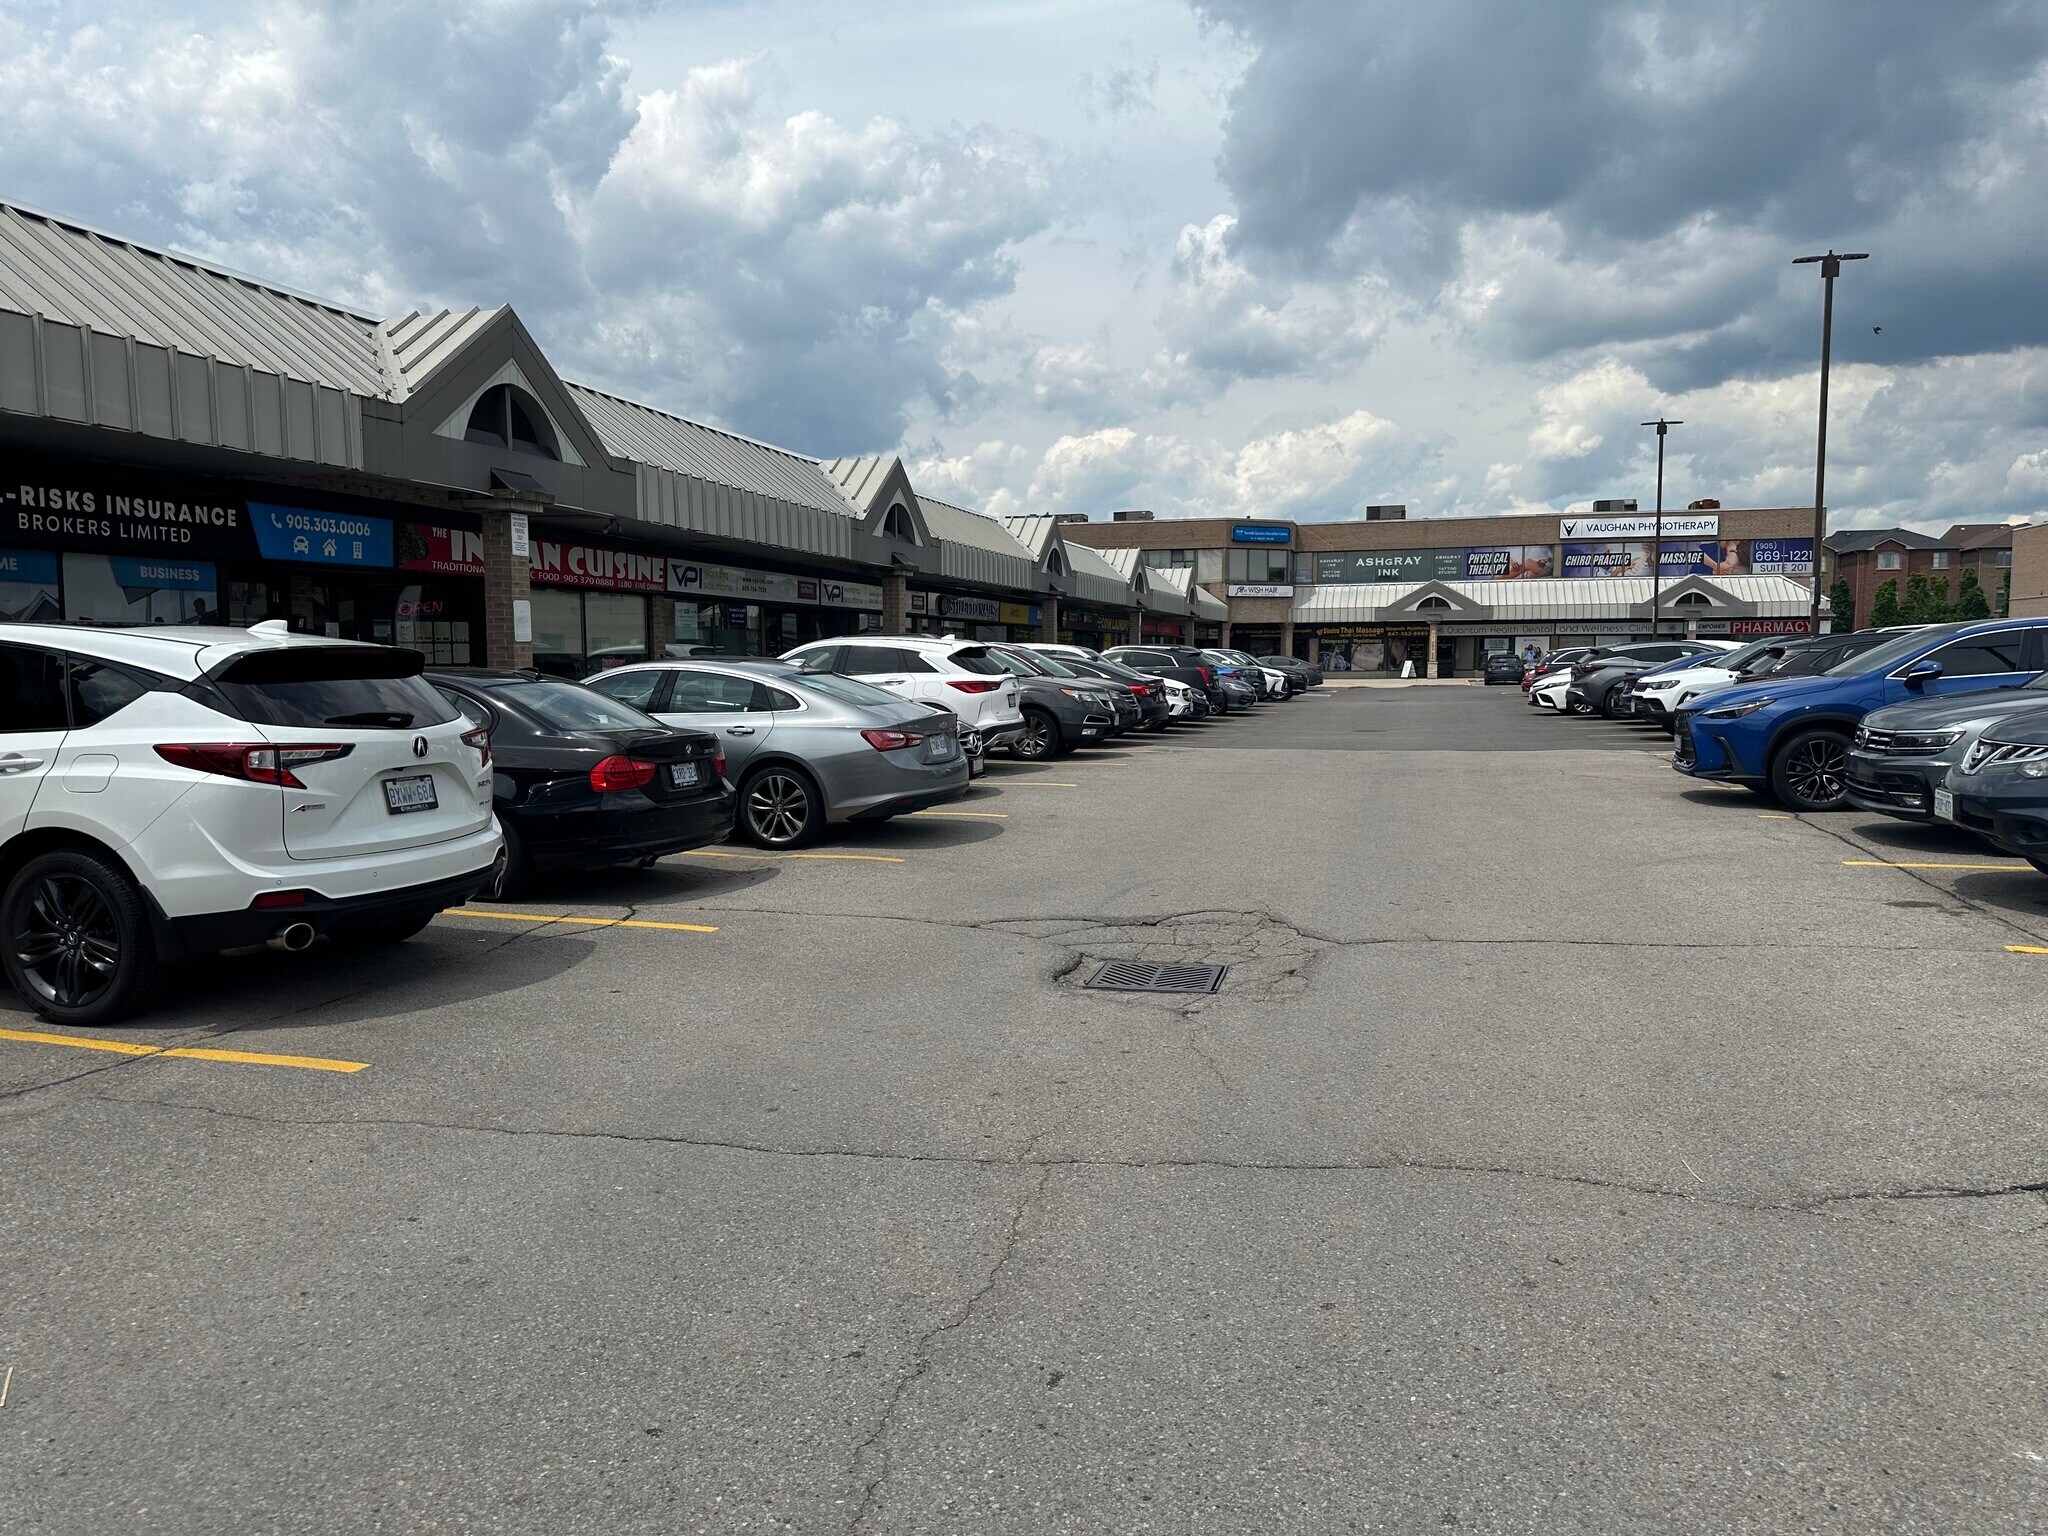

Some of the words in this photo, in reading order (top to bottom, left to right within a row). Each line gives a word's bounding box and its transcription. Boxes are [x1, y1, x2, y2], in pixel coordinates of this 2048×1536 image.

[106, 495, 238, 527] INSURANCE
[18, 513, 111, 537] BROKERS
[119, 522, 191, 543] LIMITED
[286, 514, 371, 537] 905.303.0006
[1586, 523, 1636, 532] VAUGHAN
[1638, 521, 1716, 531] PHYSIOTHERAPY
[1755, 541, 1778, 550] (905)
[432, 526, 448, 539] THE
[567, 546, 665, 584] CUISINE
[1468, 552, 1509, 564] PHYSICAL
[1659, 552, 1704, 565] MASSAGE
[1755, 550, 1813, 562] 669-1221
[1356, 556, 1423, 567] ASHGRAY
[140, 566, 200, 581] BUSINESS
[1377, 568, 1400, 576] INK
[1468, 564, 1507, 575] THERAPY
[1760, 564, 1788, 573] SUITE
[1791, 563, 1808, 572] 201
[431, 560, 486, 574] TRADITIONA
[538, 572, 560, 582] FOOD
[563, 574, 579, 583] 905
[579, 576, 594, 585] 370
[595, 578, 614, 587] 0880
[635, 581, 647, 590] FINE
[646, 583, 664, 592] DINING
[671, 563, 703, 589] VPI
[823, 584, 844, 603] VPI
[398, 600, 444, 616] OPEN
[1355, 627, 1385, 636] Massage
[1446, 626, 1487, 634] Quantum
[1490, 625, 1519, 634] Health
[1522, 625, 1553, 633] Dental
[1558, 624, 1578, 633] and
[1580, 624, 1625, 633] Wellness
